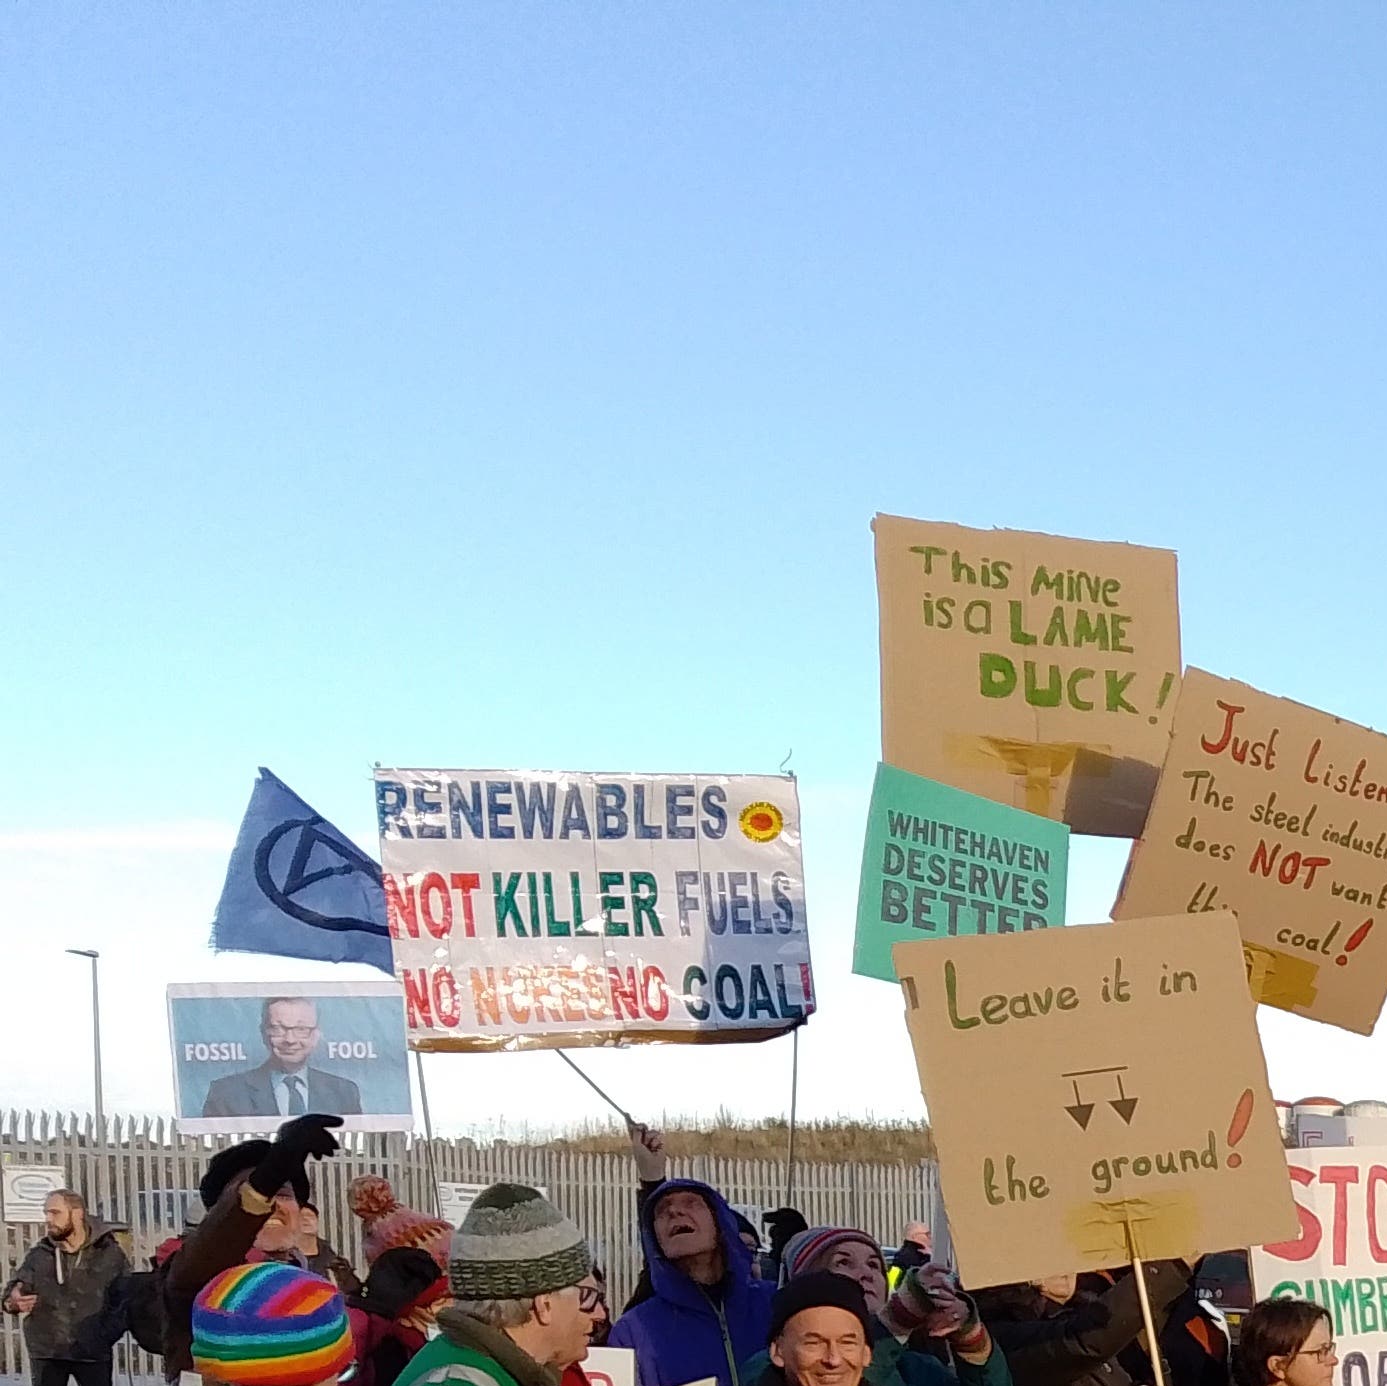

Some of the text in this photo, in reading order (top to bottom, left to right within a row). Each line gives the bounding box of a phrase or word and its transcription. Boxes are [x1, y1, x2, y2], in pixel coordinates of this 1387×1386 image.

[909, 545, 1012, 590] This
[922, 592, 1134, 653] is a LAME
[979, 652, 1174, 725] DUCK!
[1201, 700, 1279, 770] Just
[376, 780, 728, 840] RENEWABLES
[1183, 770, 1234, 811] The
[1250, 792, 1318, 837] steel
[887, 809, 1050, 874] WHITEHAVEN
[1175, 817, 1235, 860] does
[1249, 839, 1331, 889] NOT
[382, 870, 794, 939] NOT KILLER FUELS
[882, 842, 1049, 910] DESERVES
[1276, 918, 1373, 966] coal!
[403, 967, 461, 1029] NO
[608, 965, 670, 1021] NO
[945, 958, 1197, 1029] Leave it in
[185, 1041, 378, 1061] FOSSIL FOOL
[984, 1088, 1255, 1206] the ground!
